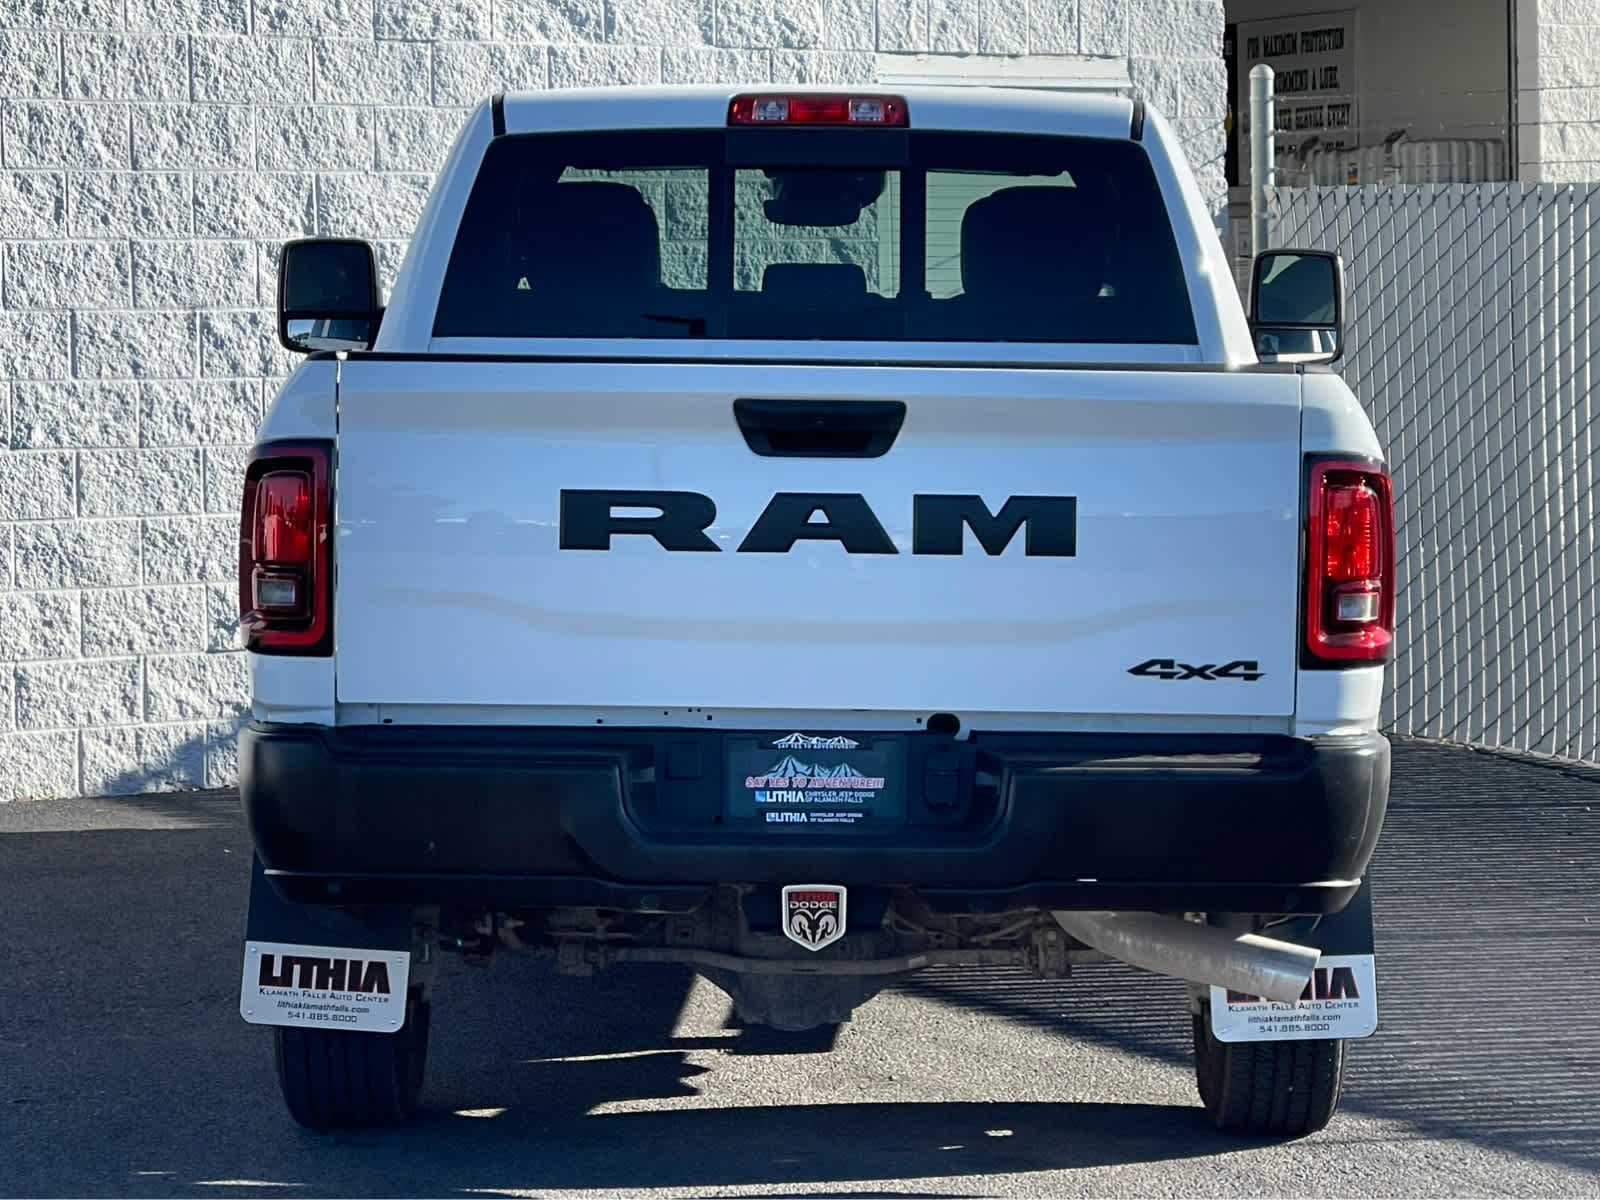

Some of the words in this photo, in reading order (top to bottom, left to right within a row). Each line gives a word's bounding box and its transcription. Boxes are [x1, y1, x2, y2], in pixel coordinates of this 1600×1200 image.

[1247, 36, 1260, 59] FOR
[1263, 32, 1297, 57] MAXIMUM
[1301, 28, 1344, 53] PROTECTION
[1311, 66, 1317, 90] A
[1295, 105, 1324, 129] SERVICE
[1327, 103, 1351, 127] EVERY
[560, 488, 1077, 558] RAM
[1127, 658, 1266, 682] 4x4
[745, 776, 766, 788] SAY
[768, 776, 790, 788] YES
[791, 777, 808, 788] TO
[808, 777, 886, 789] ADVENTURE!!!
[766, 790, 804, 803] LITHIA
[775, 812, 808, 823] LITHIA
[789, 900, 837, 908] DODGE
[258, 953, 391, 994] LITHIA
[276, 1000, 370, 1014] lithiaklamathfalls.com
[287, 1011, 358, 1023] 541.885.8000
[1247, 1013, 1341, 1024] lithiaklamathfalls.com
[1258, 1023, 1330, 1033] 541.885.8000
